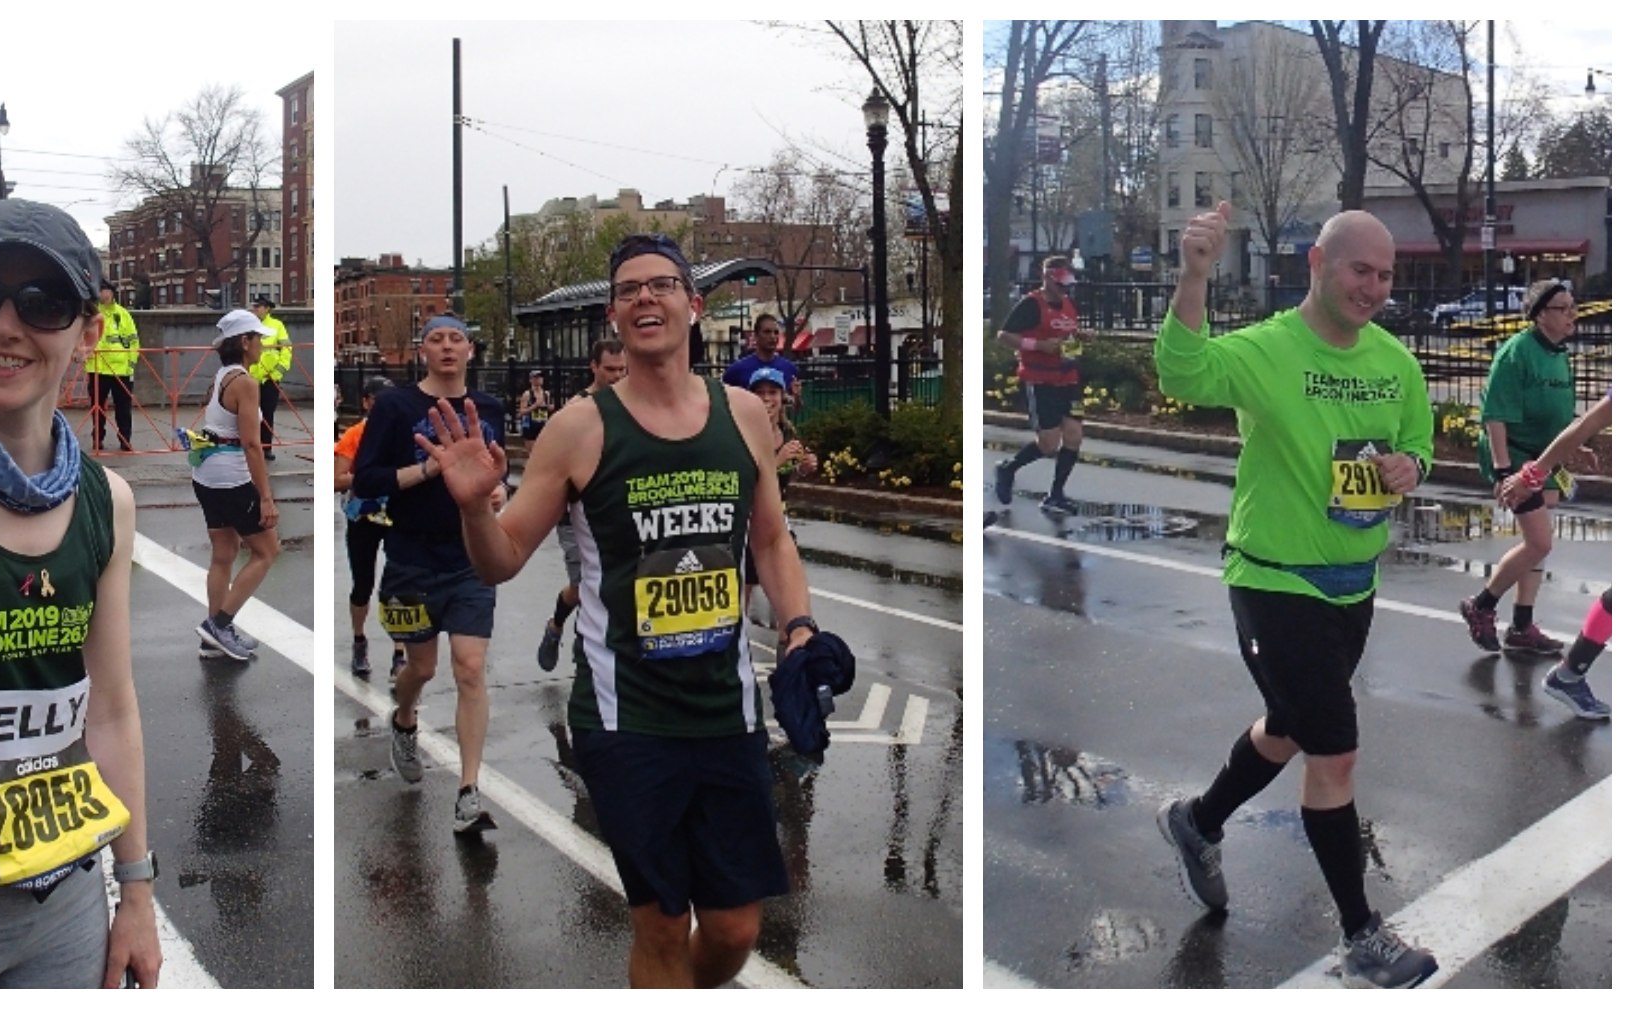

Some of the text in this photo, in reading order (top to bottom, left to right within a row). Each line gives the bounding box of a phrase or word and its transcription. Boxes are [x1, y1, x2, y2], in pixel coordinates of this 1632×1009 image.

[626, 474, 669, 492] TEAM
[1339, 462, 1395, 496] 291
[628, 482, 706, 504] BROOKLINE
[632, 503, 734, 542] WEEKS
[646, 573, 731, 618] 29058
[9, 605, 60, 630] 2019
[16, 756, 59, 777] adidas
